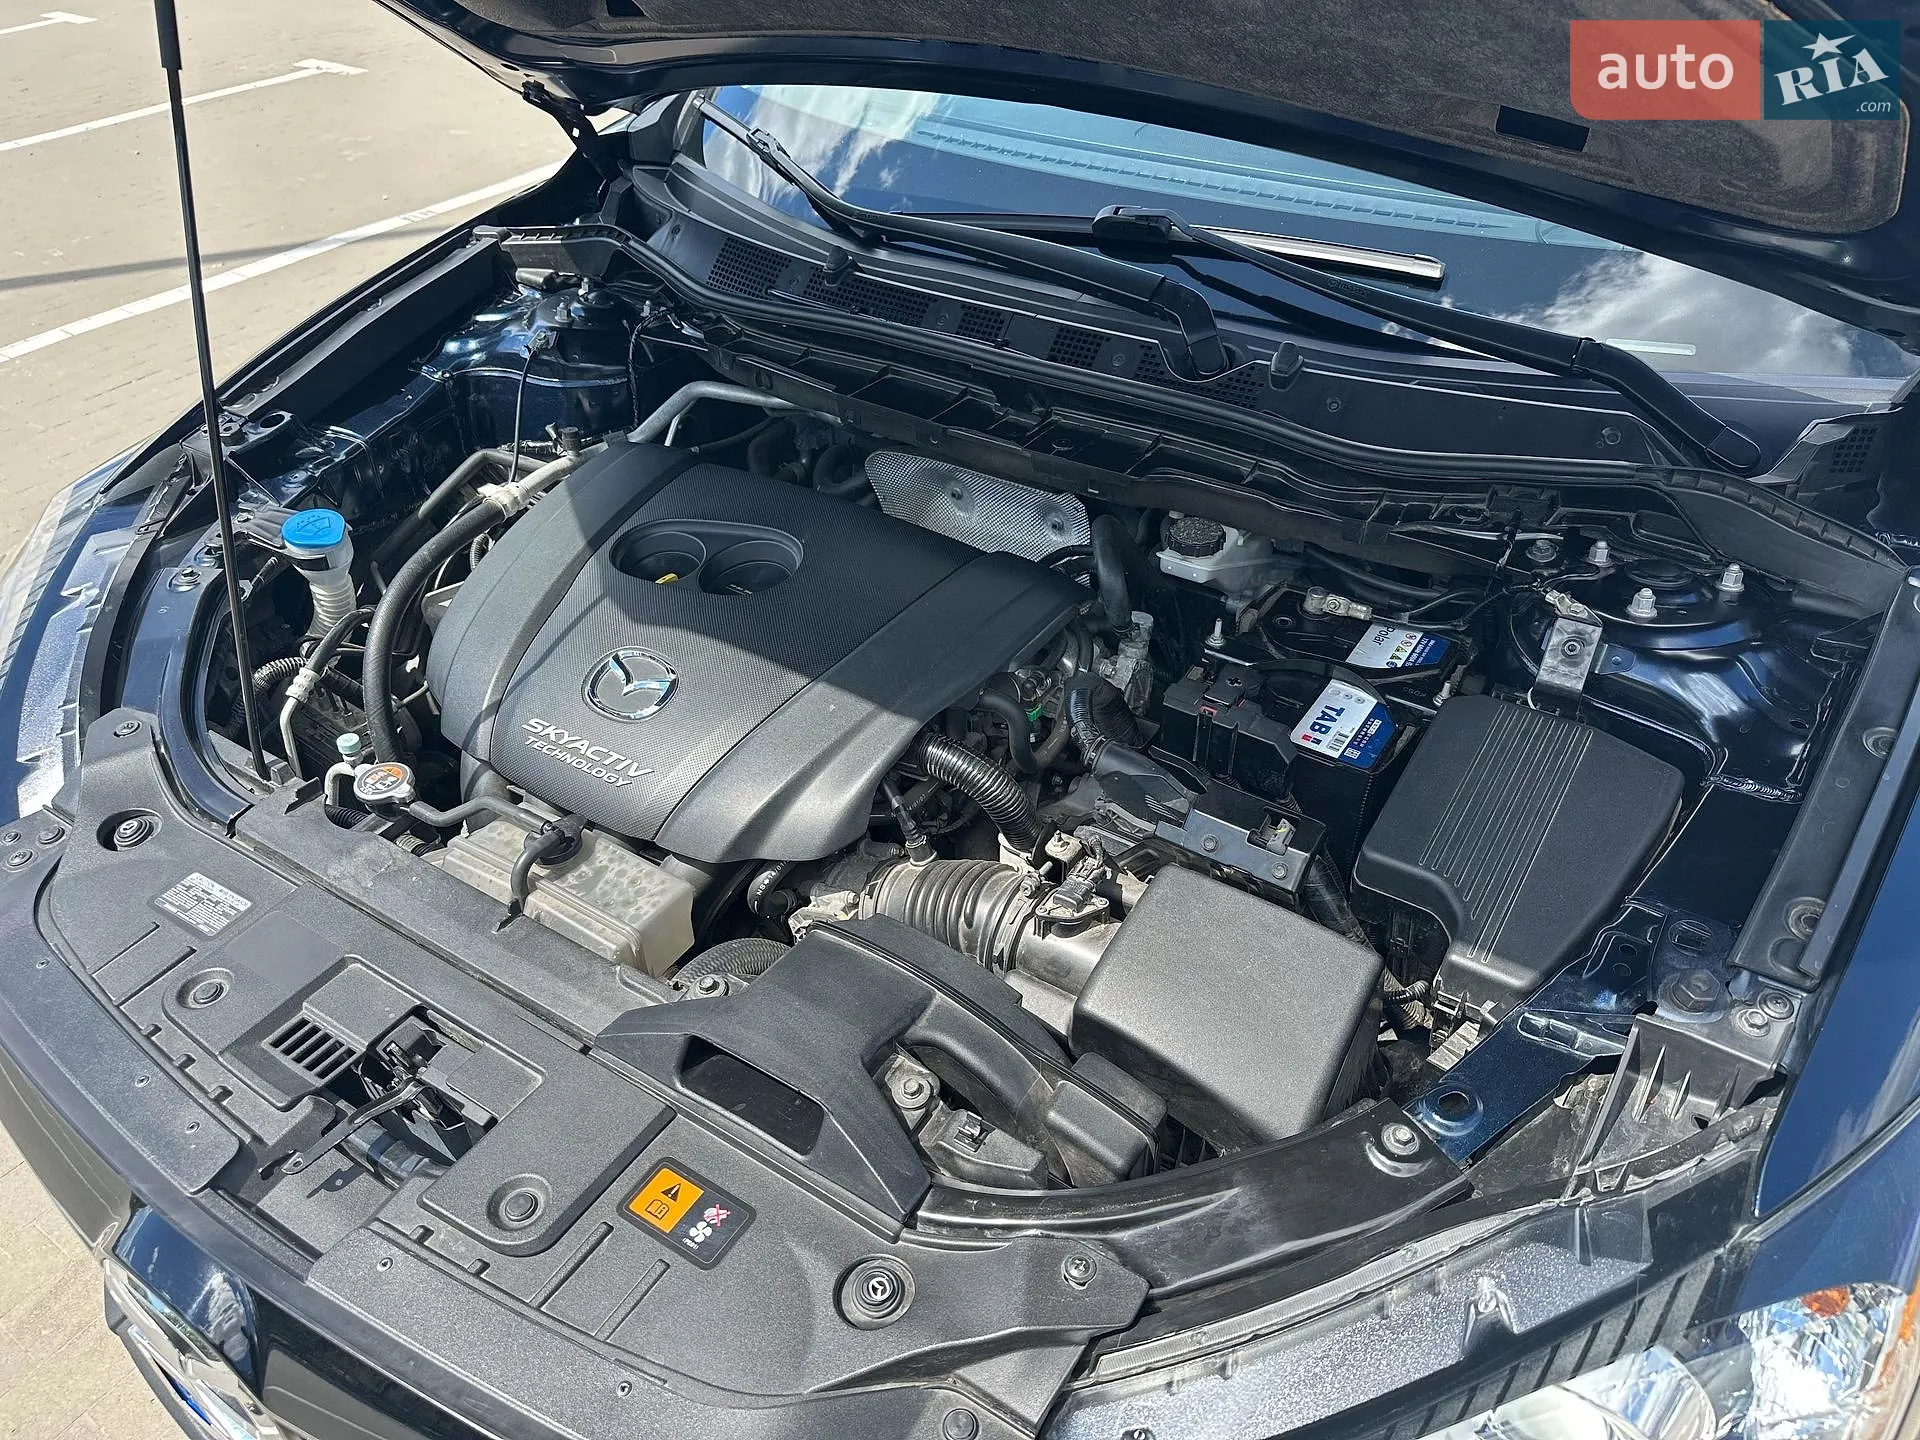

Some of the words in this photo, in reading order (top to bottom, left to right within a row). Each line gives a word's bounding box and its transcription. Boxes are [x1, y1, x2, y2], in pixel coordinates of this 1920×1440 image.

[1309, 704, 1346, 735] TAB
[521, 718, 655, 778] SKYACTIV
[524, 735, 633, 788] TECHNOLOGY
